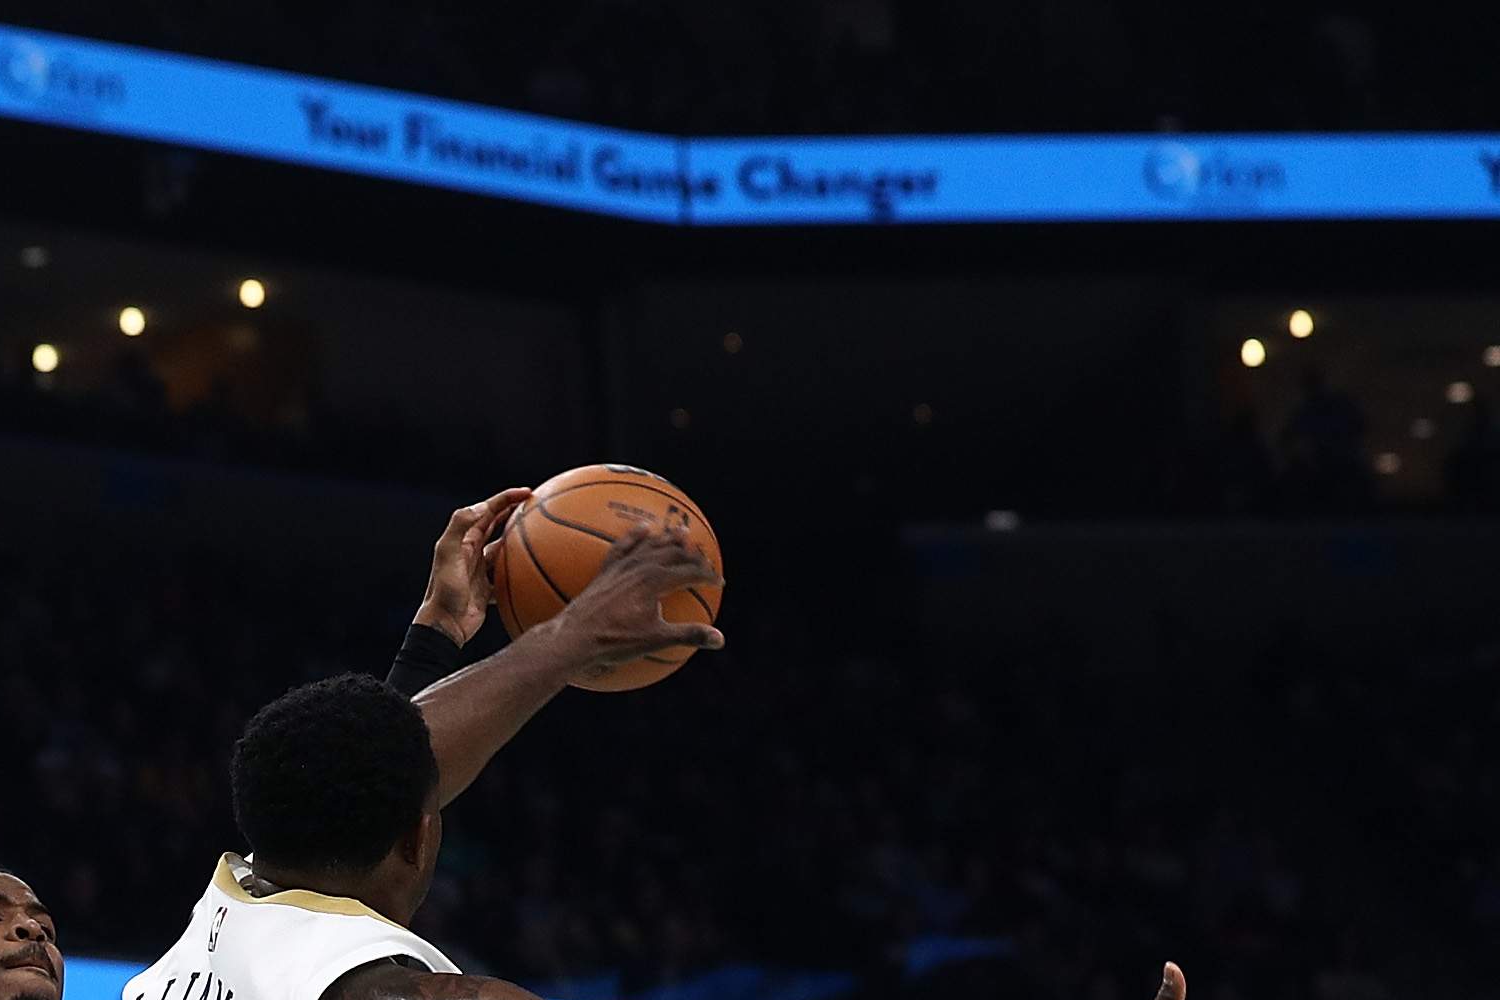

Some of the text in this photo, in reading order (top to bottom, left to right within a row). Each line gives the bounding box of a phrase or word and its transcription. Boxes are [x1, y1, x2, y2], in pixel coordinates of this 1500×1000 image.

[302, 100, 941, 224] Your Financial Game Changer
